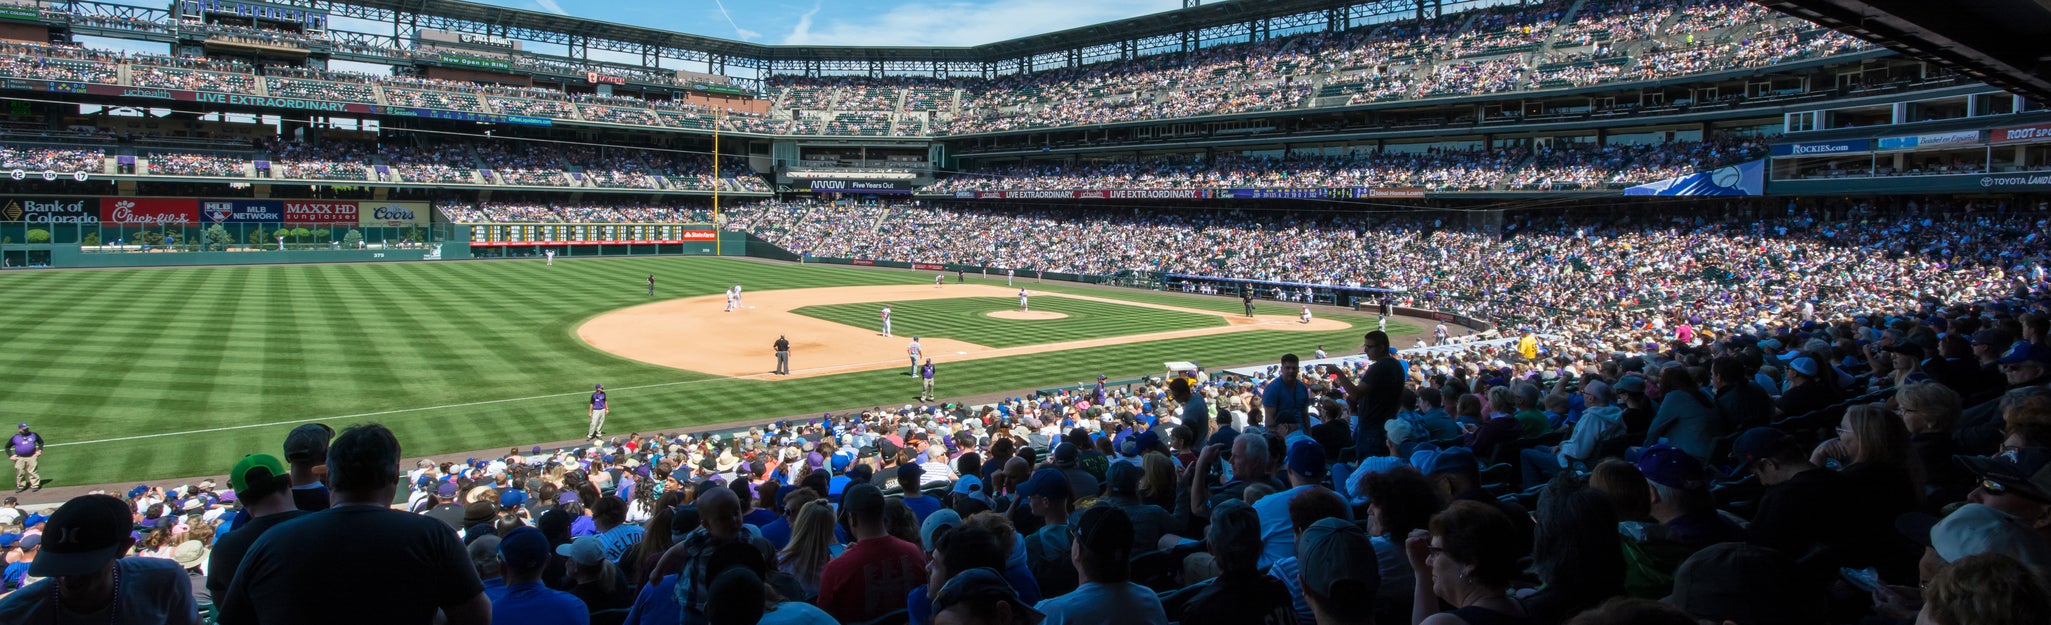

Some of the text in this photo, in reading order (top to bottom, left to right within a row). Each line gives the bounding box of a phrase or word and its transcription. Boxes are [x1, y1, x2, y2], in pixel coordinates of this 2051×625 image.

[237, 3, 327, 25] ROOFTOP
[124, 87, 171, 99] uchealth
[196, 92, 348, 112] LIVE EXTRAORDINARY.
[2007, 128, 2036, 140] ROOT
[811, 180, 846, 189] ARROW
[1994, 178, 2026, 186] TOYOTA
[1006, 190, 1075, 198] LIVE EXTRAORDINARY.
[1110, 190, 1197, 198] LIVE EXTRAORDINARY.
[24, 200, 84, 212] Bank of
[287, 204, 356, 214] MAXX HD
[24, 212, 98, 224] Colorado
[374, 206, 414, 220] Coors
